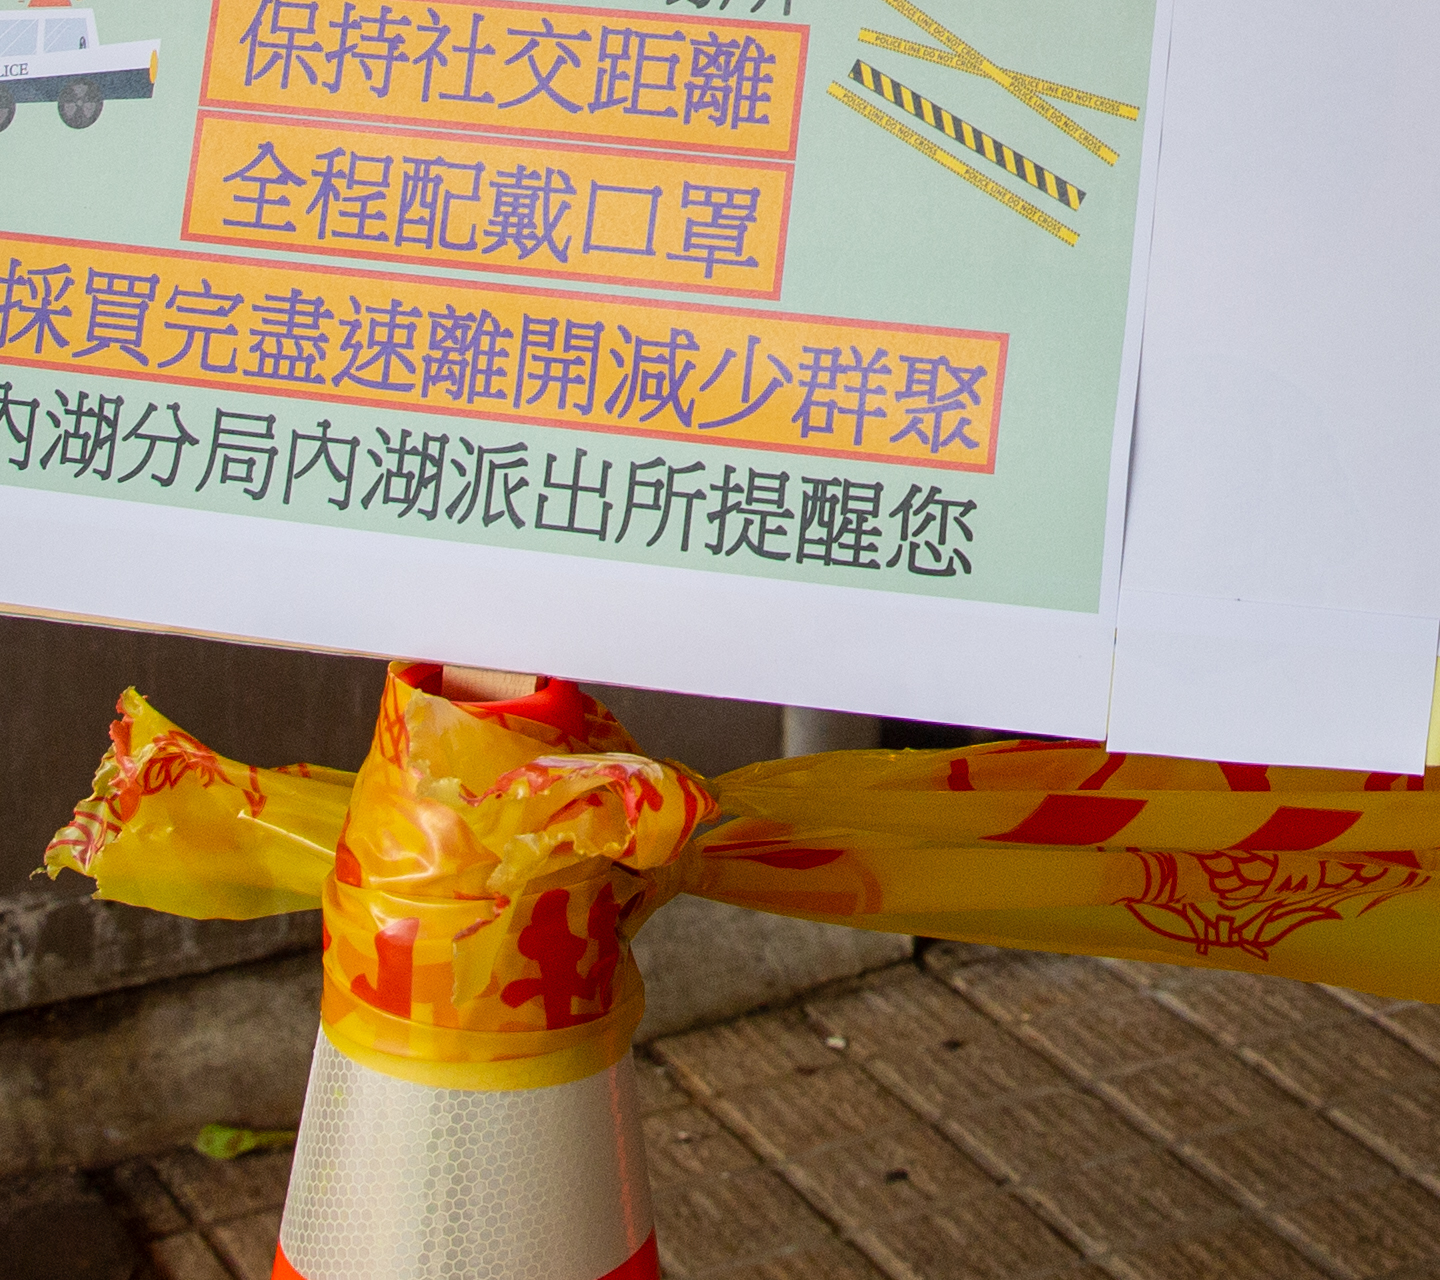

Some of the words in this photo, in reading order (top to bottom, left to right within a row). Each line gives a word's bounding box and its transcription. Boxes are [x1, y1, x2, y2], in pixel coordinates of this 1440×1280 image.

[222, 140, 760, 279] 全程配戴口罩
